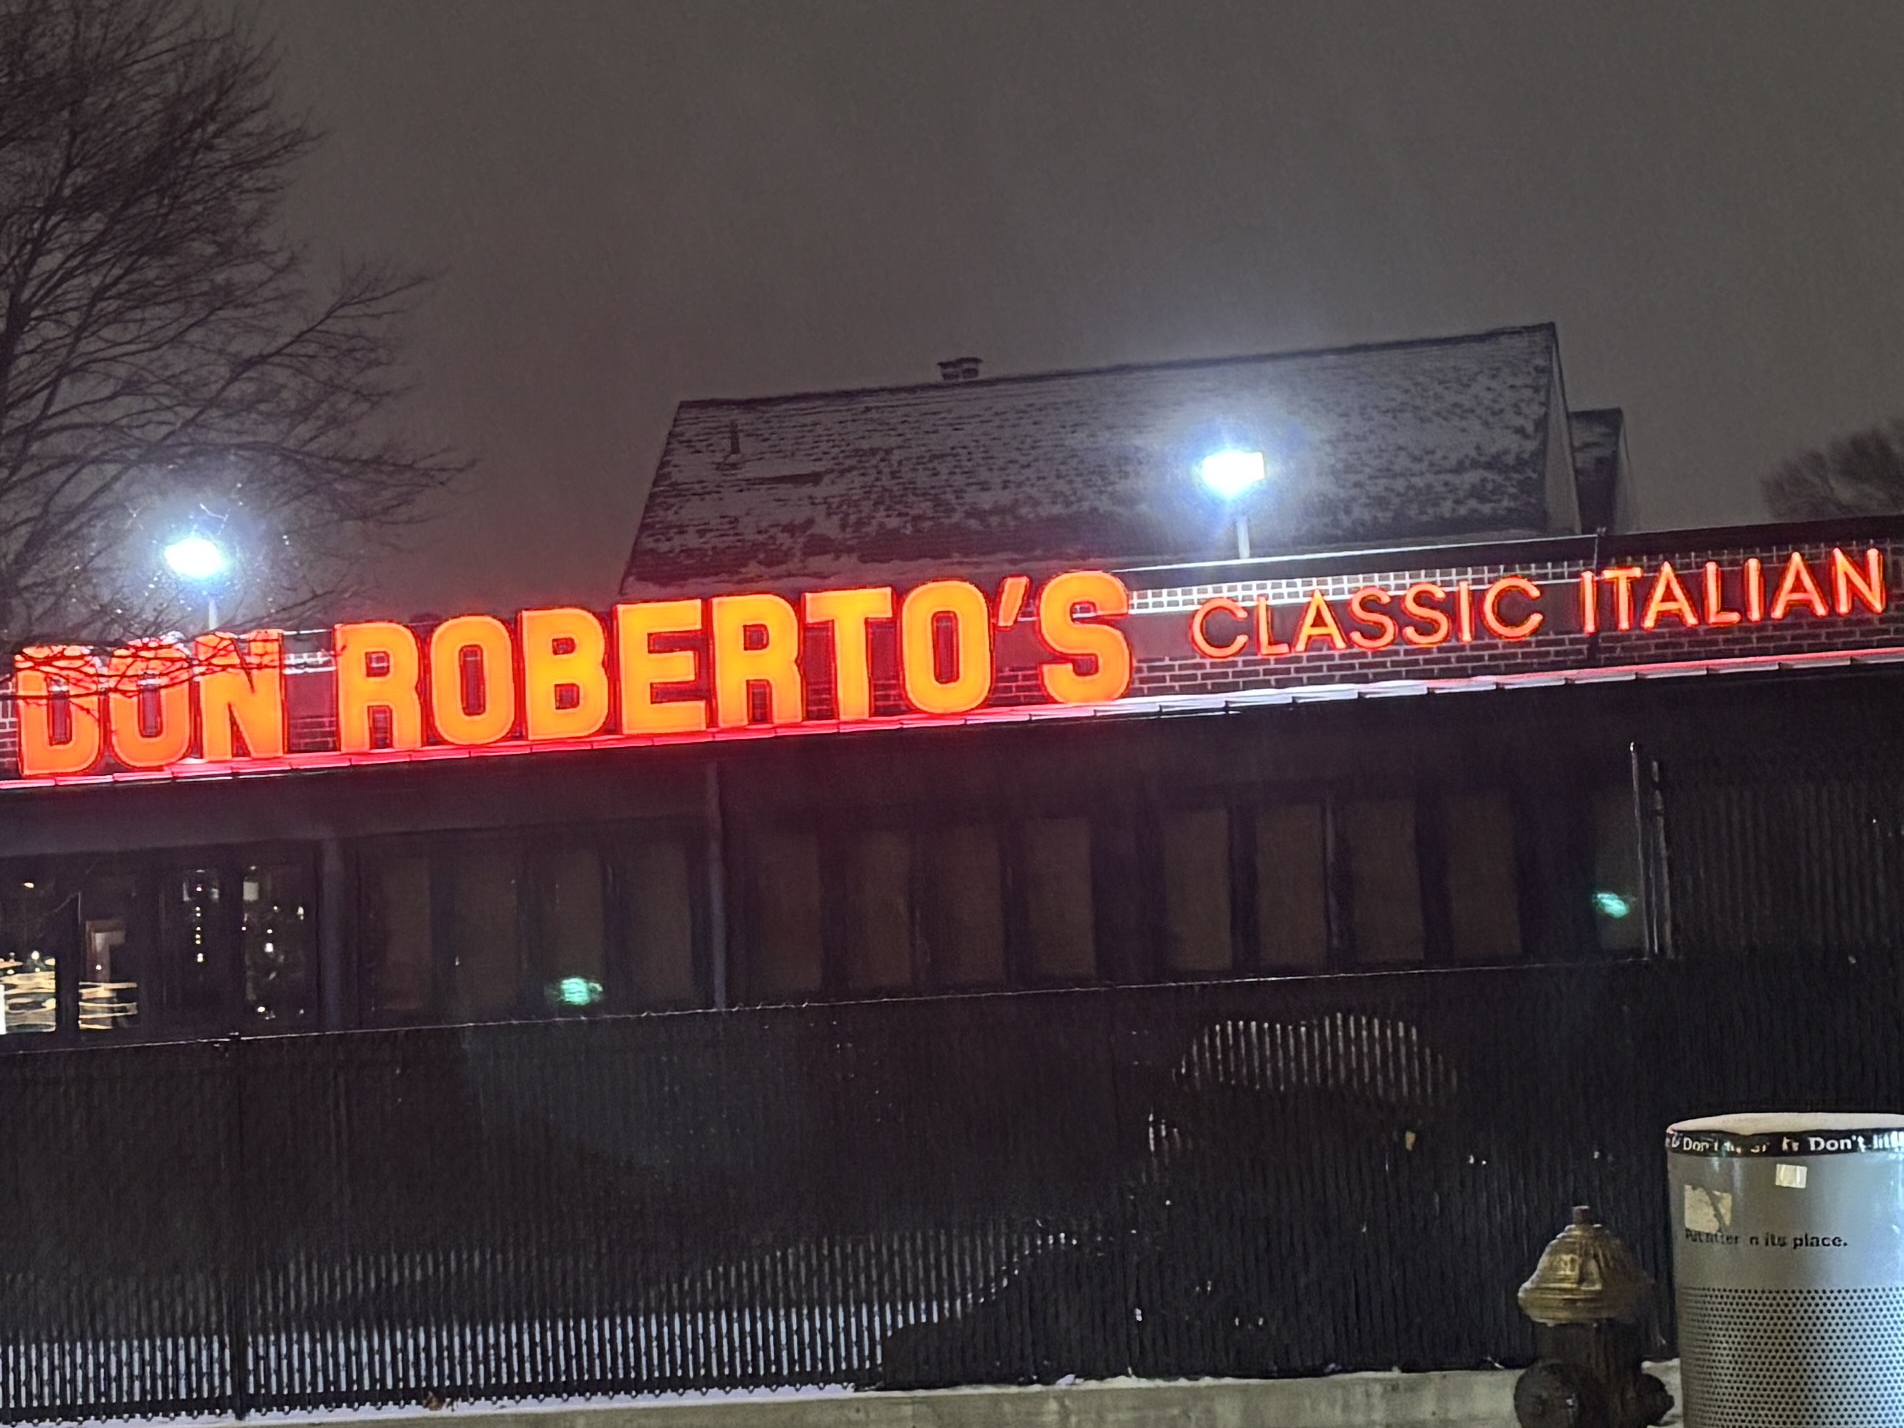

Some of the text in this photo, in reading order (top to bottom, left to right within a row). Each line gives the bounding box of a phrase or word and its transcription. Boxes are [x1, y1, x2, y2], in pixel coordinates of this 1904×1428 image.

[1191, 547, 1886, 660] CLASSIC ITALIAN
[14, 569, 1132, 777] DON ROBERTO'S
[1683, 1135, 1719, 1152] Dont
[1807, 1132, 1867, 1153] Don't
[1764, 1232, 1787, 1247] its
[1793, 1233, 1848, 1250] place.
